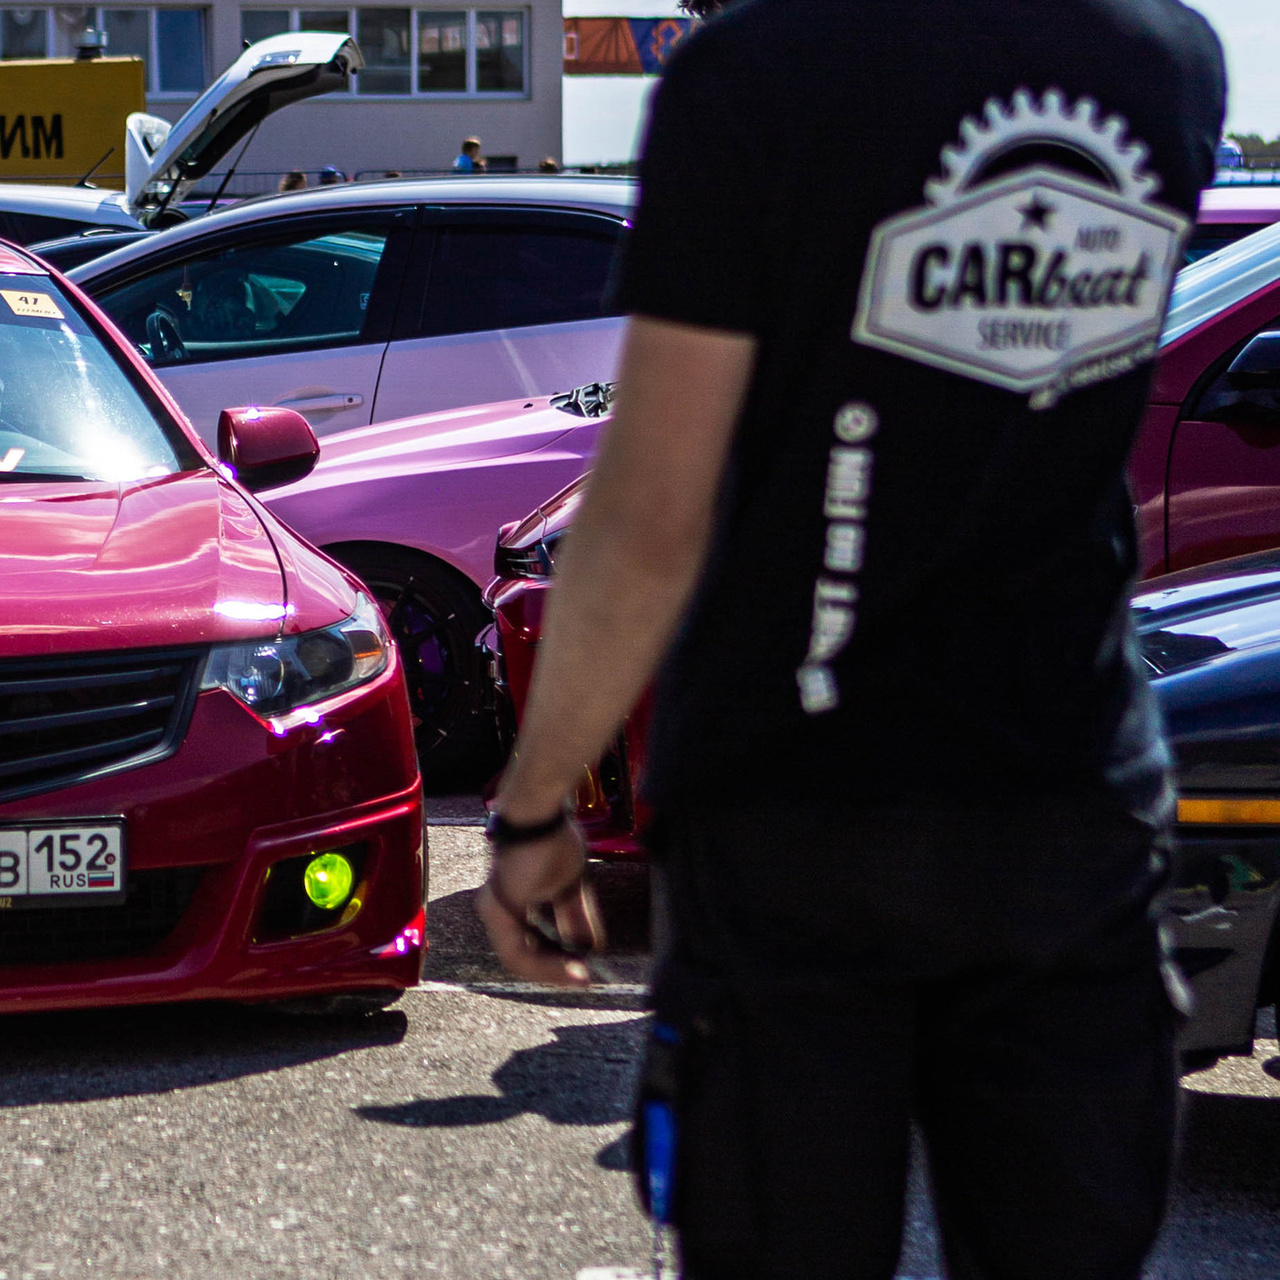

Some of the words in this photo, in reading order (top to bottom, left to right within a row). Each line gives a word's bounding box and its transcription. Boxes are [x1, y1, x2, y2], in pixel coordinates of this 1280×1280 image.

[976, 318, 1070, 350] SERVICE
[34, 832, 110, 873] 152
[49, 873, 87, 889] RUS
